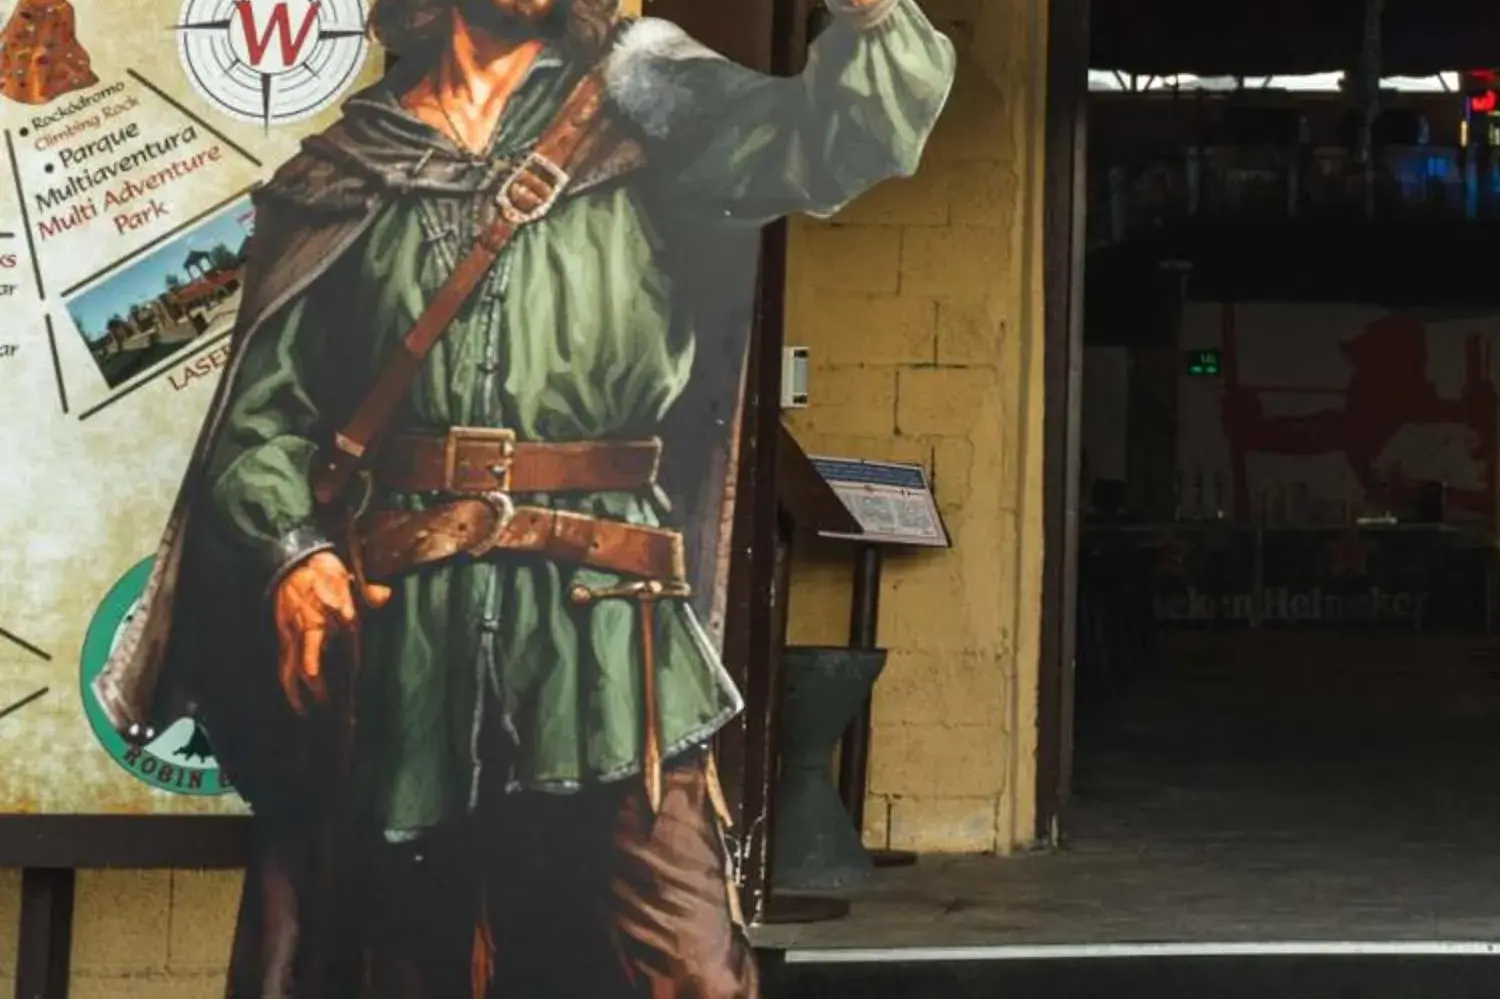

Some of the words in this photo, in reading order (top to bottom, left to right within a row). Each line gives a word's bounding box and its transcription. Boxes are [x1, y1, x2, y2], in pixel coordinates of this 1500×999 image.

[34, 115, 101, 151] Climbing
[58, 120, 140, 170] Parque
[35, 125, 198, 213] Multiaventura
[37, 194, 98, 242] Multi
[103, 144, 223, 210] Adventure
[113, 198, 170, 236] Park
[168, 344, 231, 391] LASE
